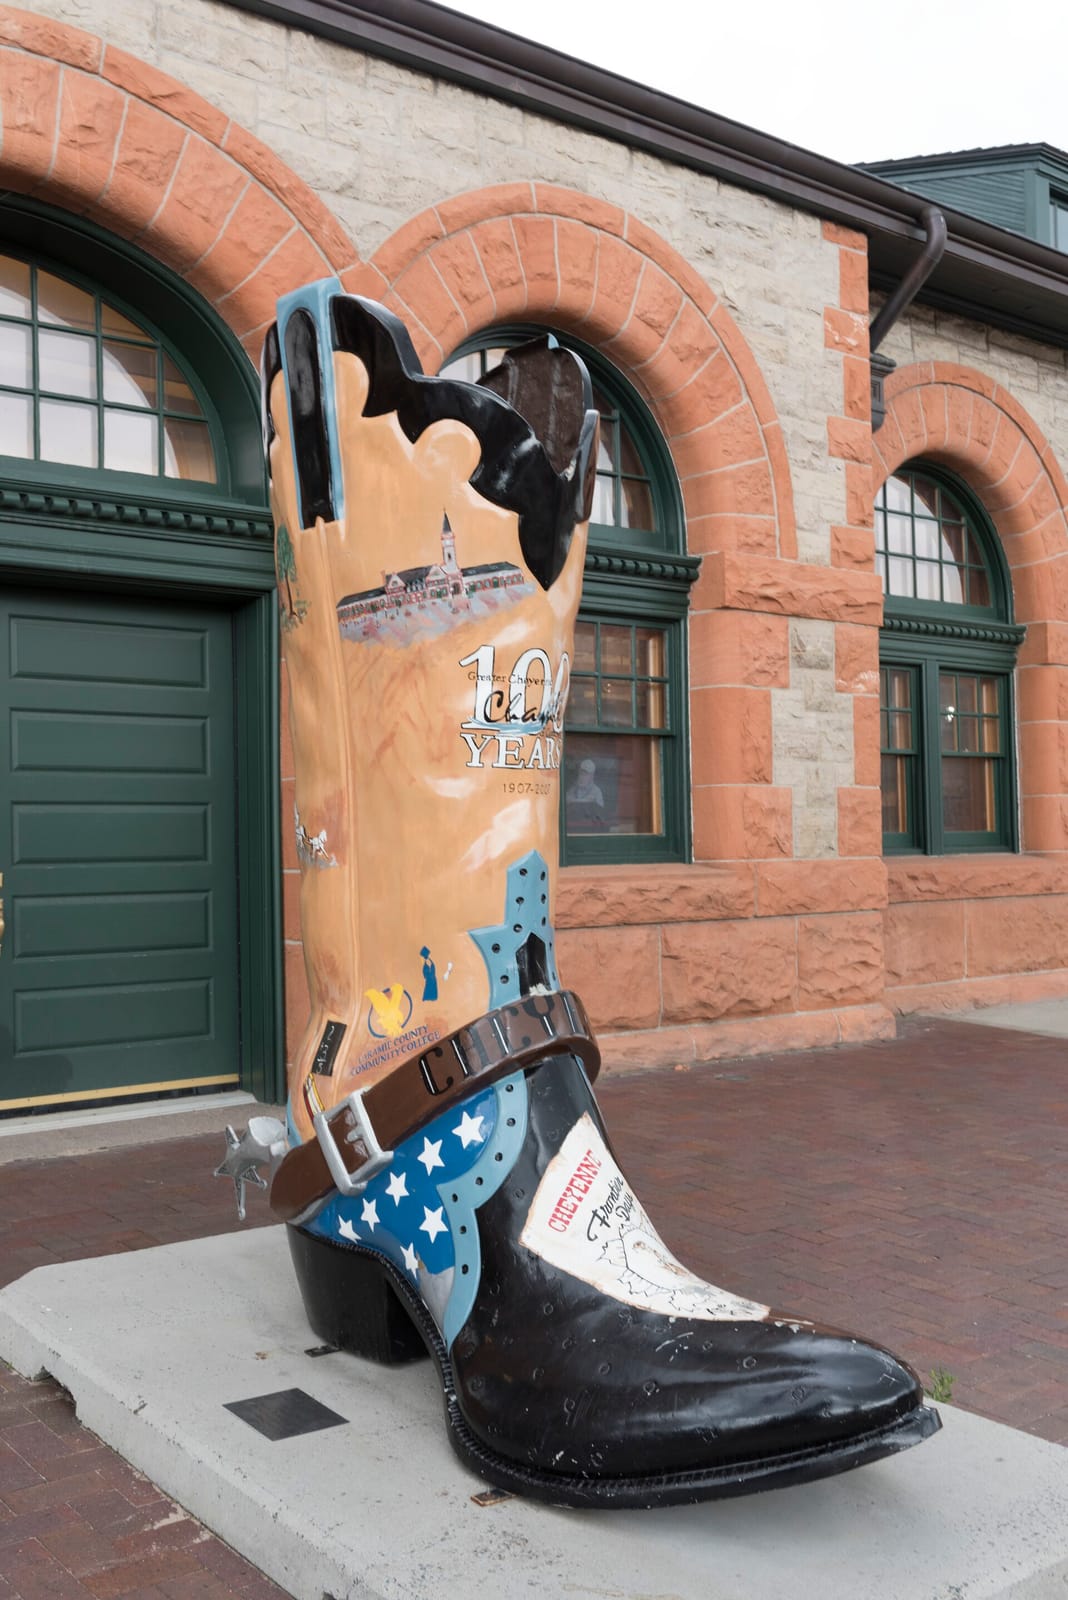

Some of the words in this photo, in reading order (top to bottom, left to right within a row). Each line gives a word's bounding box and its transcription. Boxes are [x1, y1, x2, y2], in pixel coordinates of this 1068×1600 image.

[459, 644, 570, 734] 100
[467, 671, 507, 684] Greater
[460, 732, 562, 770] YEARS
[350, 1046, 401, 1076] COMMUNITY
[400, 1031, 440, 1054] COLLEGE
[393, 1024, 429, 1046] COUNTY
[548, 1149, 602, 1233] CHEYENNE
[586, 1176, 624, 1242] Frontier
